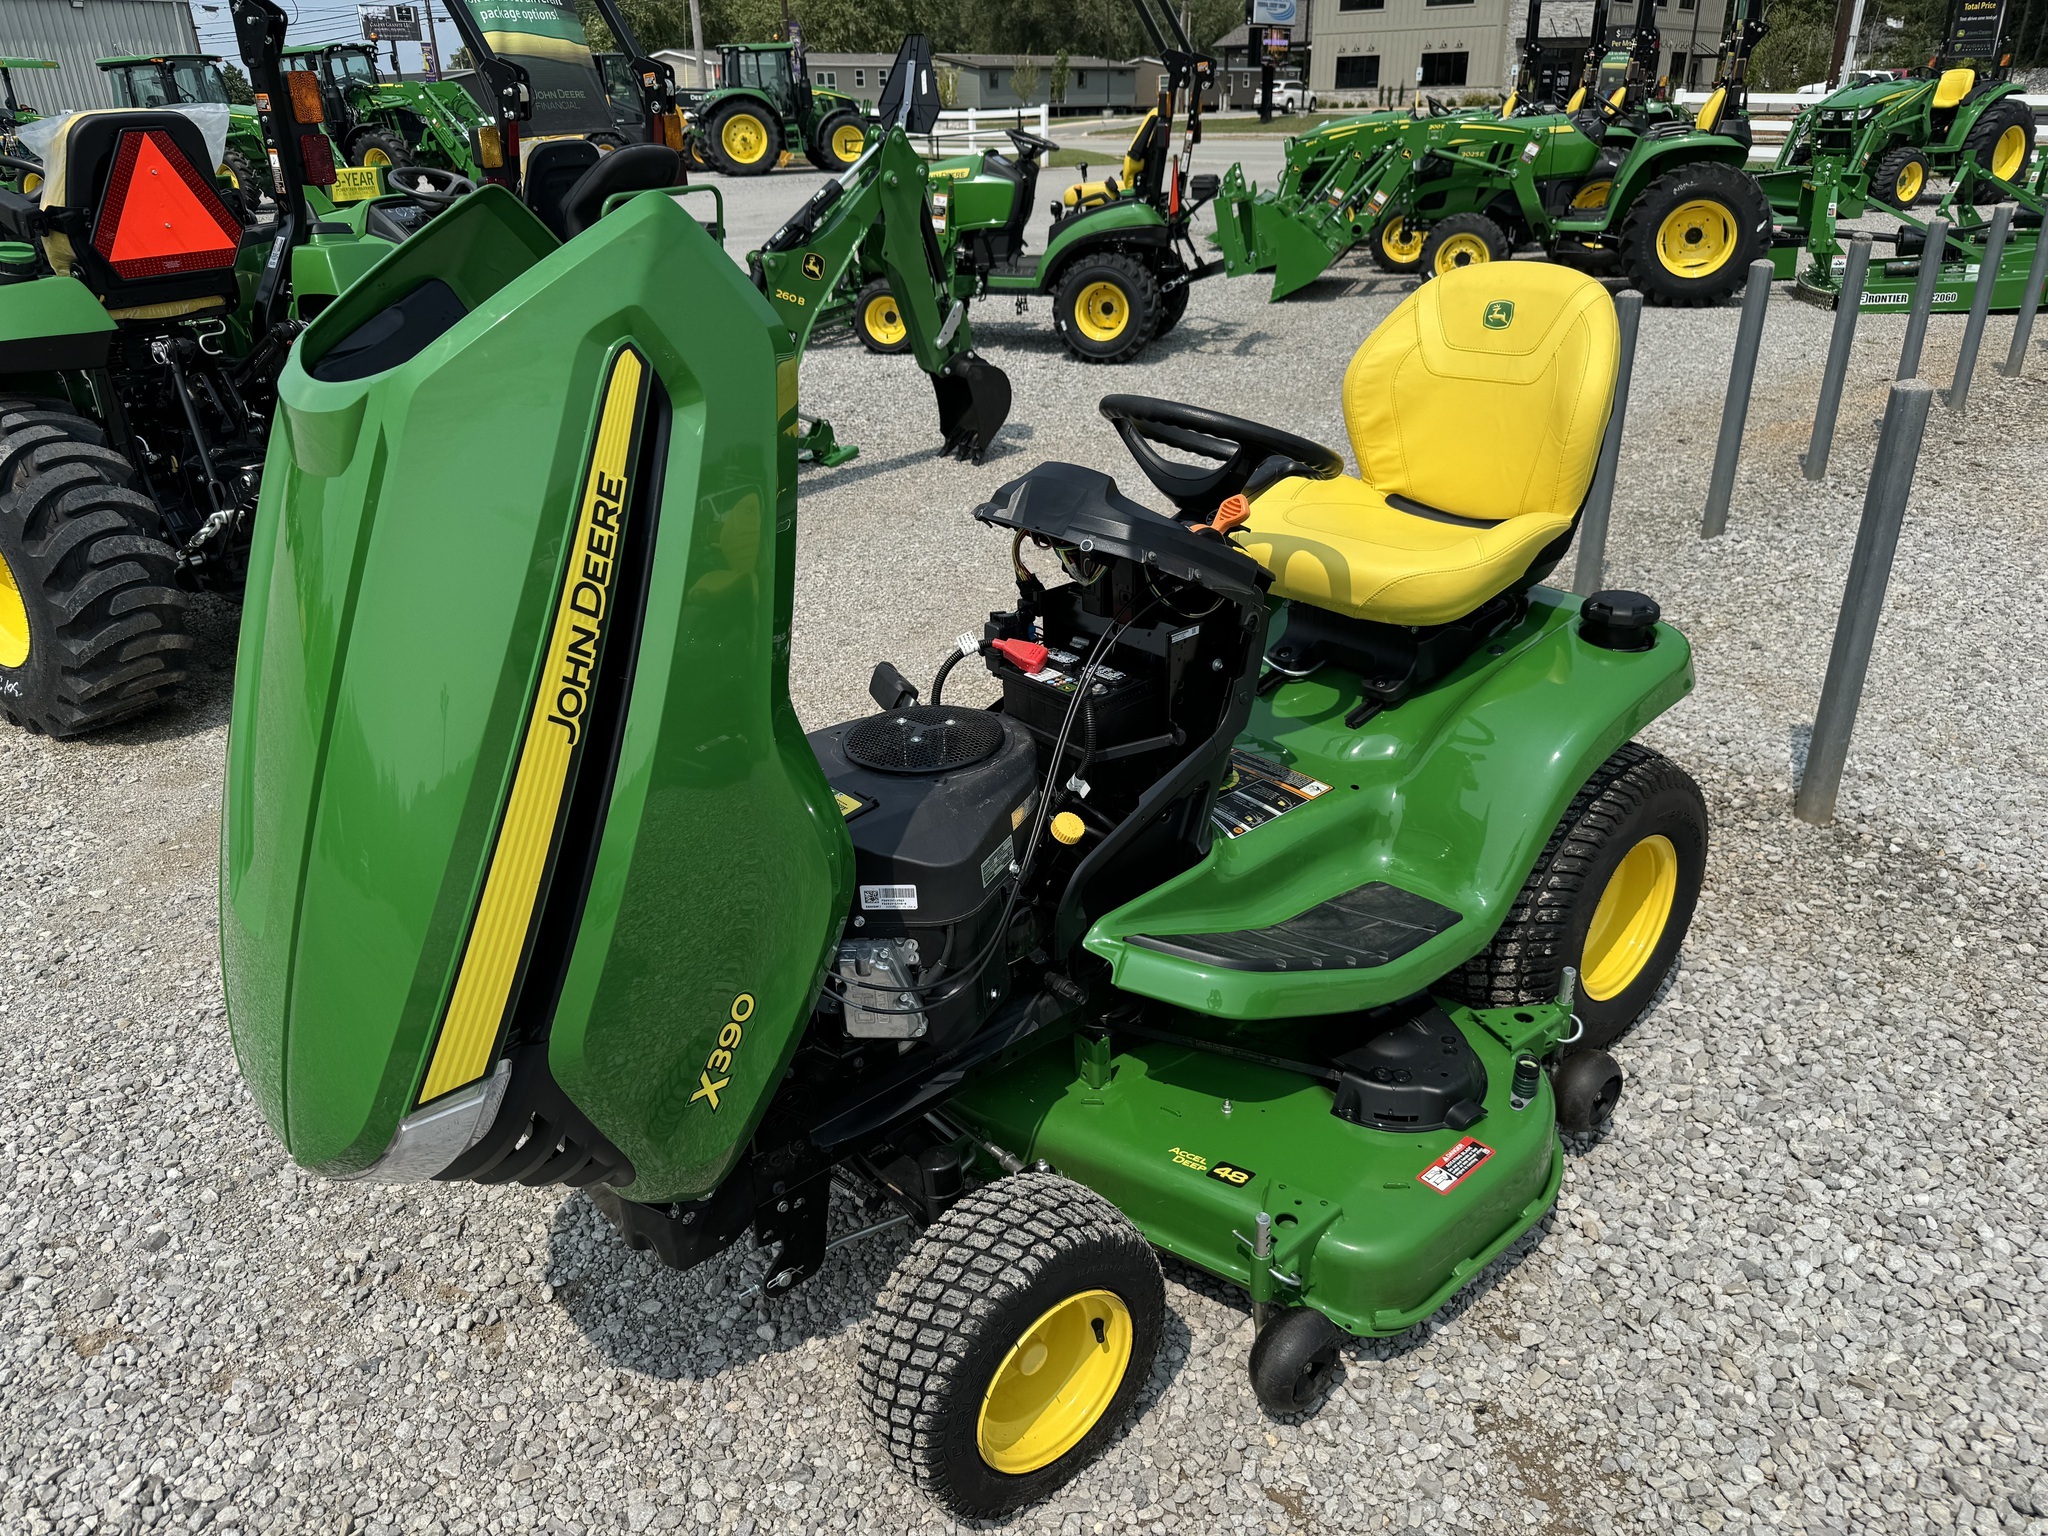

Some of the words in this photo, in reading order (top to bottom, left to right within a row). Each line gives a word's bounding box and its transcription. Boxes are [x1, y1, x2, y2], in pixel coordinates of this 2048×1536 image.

[480, 6, 521, 23] package
[522, 8, 560, 22] options!
[534, 90, 558, 99] JOHN
[559, 89, 586, 98] DEERE
[535, 101, 580, 110] FINANCIAL
[335, 172, 374, 187] 5-YEAR
[570, 470, 625, 620] DEERE
[547, 624, 597, 745] JOHN
[688, 992, 756, 1112] X390
[1168, 1147, 1206, 1165] ACCEL
[1445, 1143, 1464, 1158] DANGER
[1172, 1155, 1207, 1171] DEEP
[1213, 1167, 1249, 1183] 48
